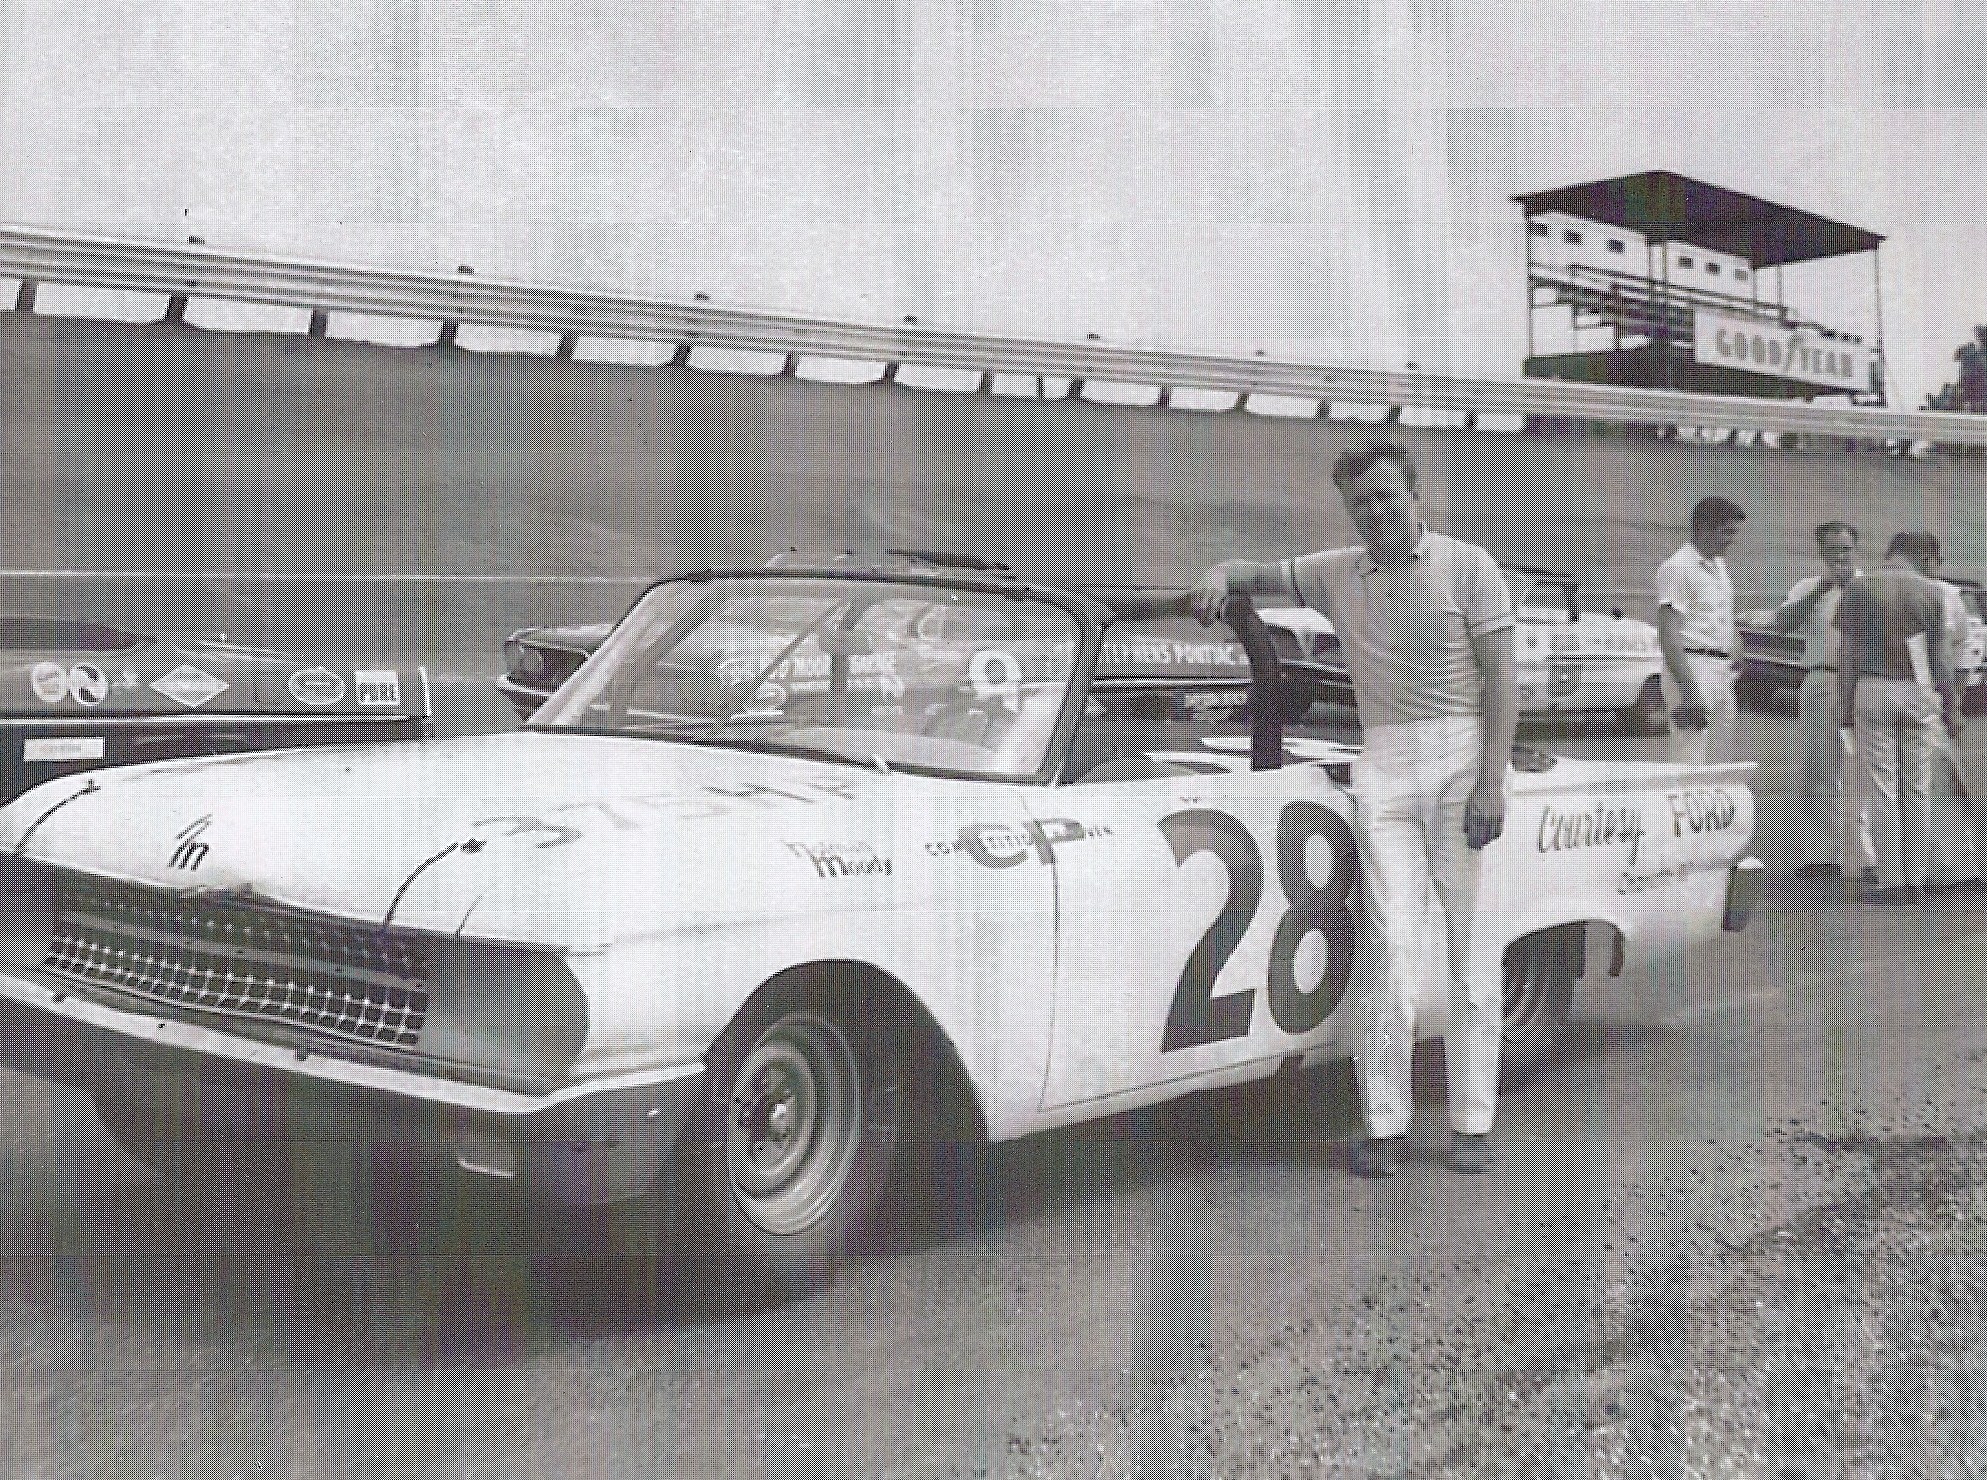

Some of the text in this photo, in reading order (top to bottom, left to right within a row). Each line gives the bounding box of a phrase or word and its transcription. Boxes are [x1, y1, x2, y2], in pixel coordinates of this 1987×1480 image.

[1715, 327, 1854, 379] GOODYEAR
[359, 683, 397, 702] PURE
[1667, 788, 1736, 838] FORD
[1157, 800, 1359, 1054] 28
